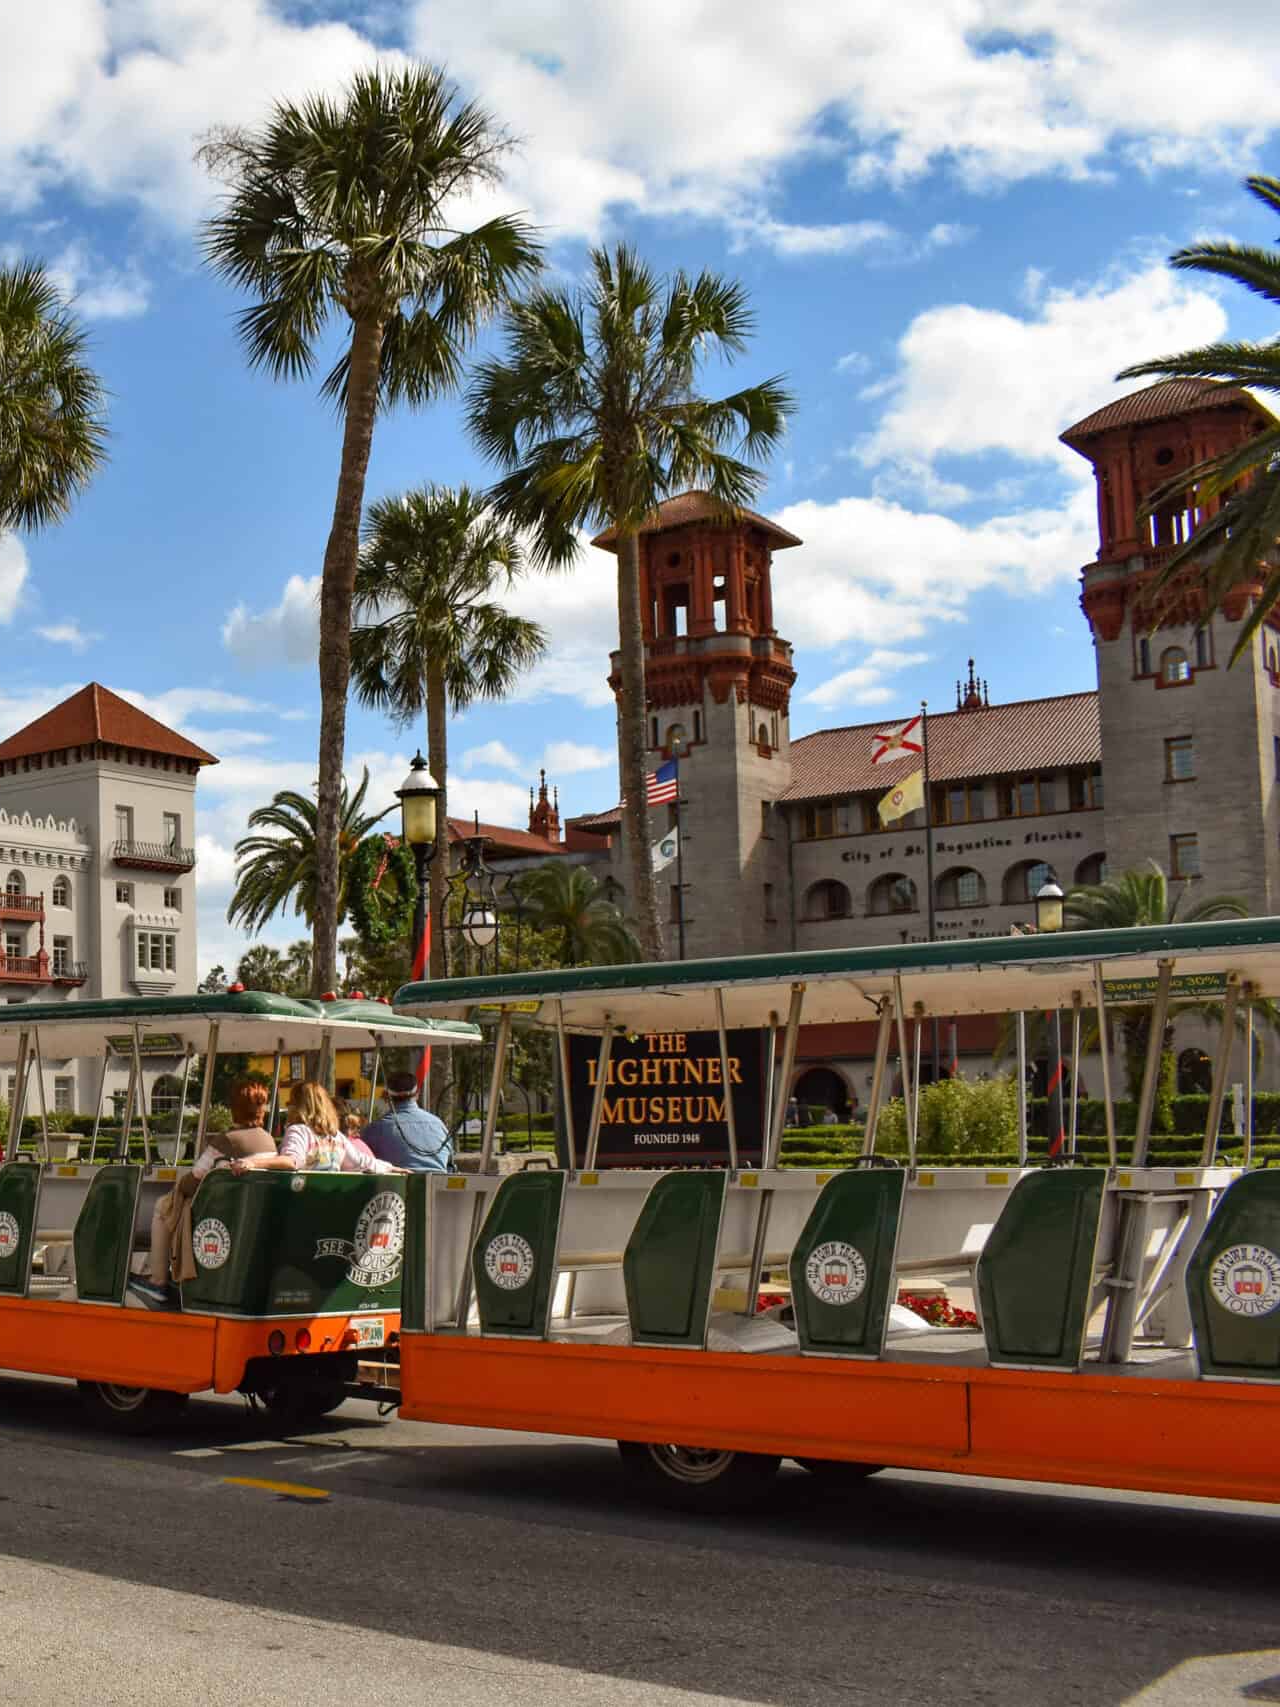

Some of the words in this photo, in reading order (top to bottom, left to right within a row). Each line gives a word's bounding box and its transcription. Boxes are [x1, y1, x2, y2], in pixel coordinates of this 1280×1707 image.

[841, 850, 870, 863] City
[880, 848, 894, 859] of
[935, 838, 1012, 855] Augustine
[1024, 830, 1083, 844] Florida
[1105, 982, 1142, 992] Save
[1185, 976, 1220, 987] 30%
[644, 1034, 687, 1053] THE
[586, 1057, 743, 1086] LIGHTNER
[599, 1096, 730, 1124] MUSEUM
[634, 1133, 680, 1145] FOUNDED
[356, 1219, 369, 1240] OLD
[322, 1240, 346, 1254] SEE
[812, 1243, 836, 1262] TOWN
[1218, 1247, 1248, 1269] TOWN
[1252, 1247, 1280, 1288] TROLLEY
[350, 1266, 369, 1284] THE
[370, 1265, 399, 1284] BEST
[808, 1262, 818, 1279] OLD
[1212, 1267, 1226, 1287] OLD
[1223, 1289, 1277, 1314] TOURS
